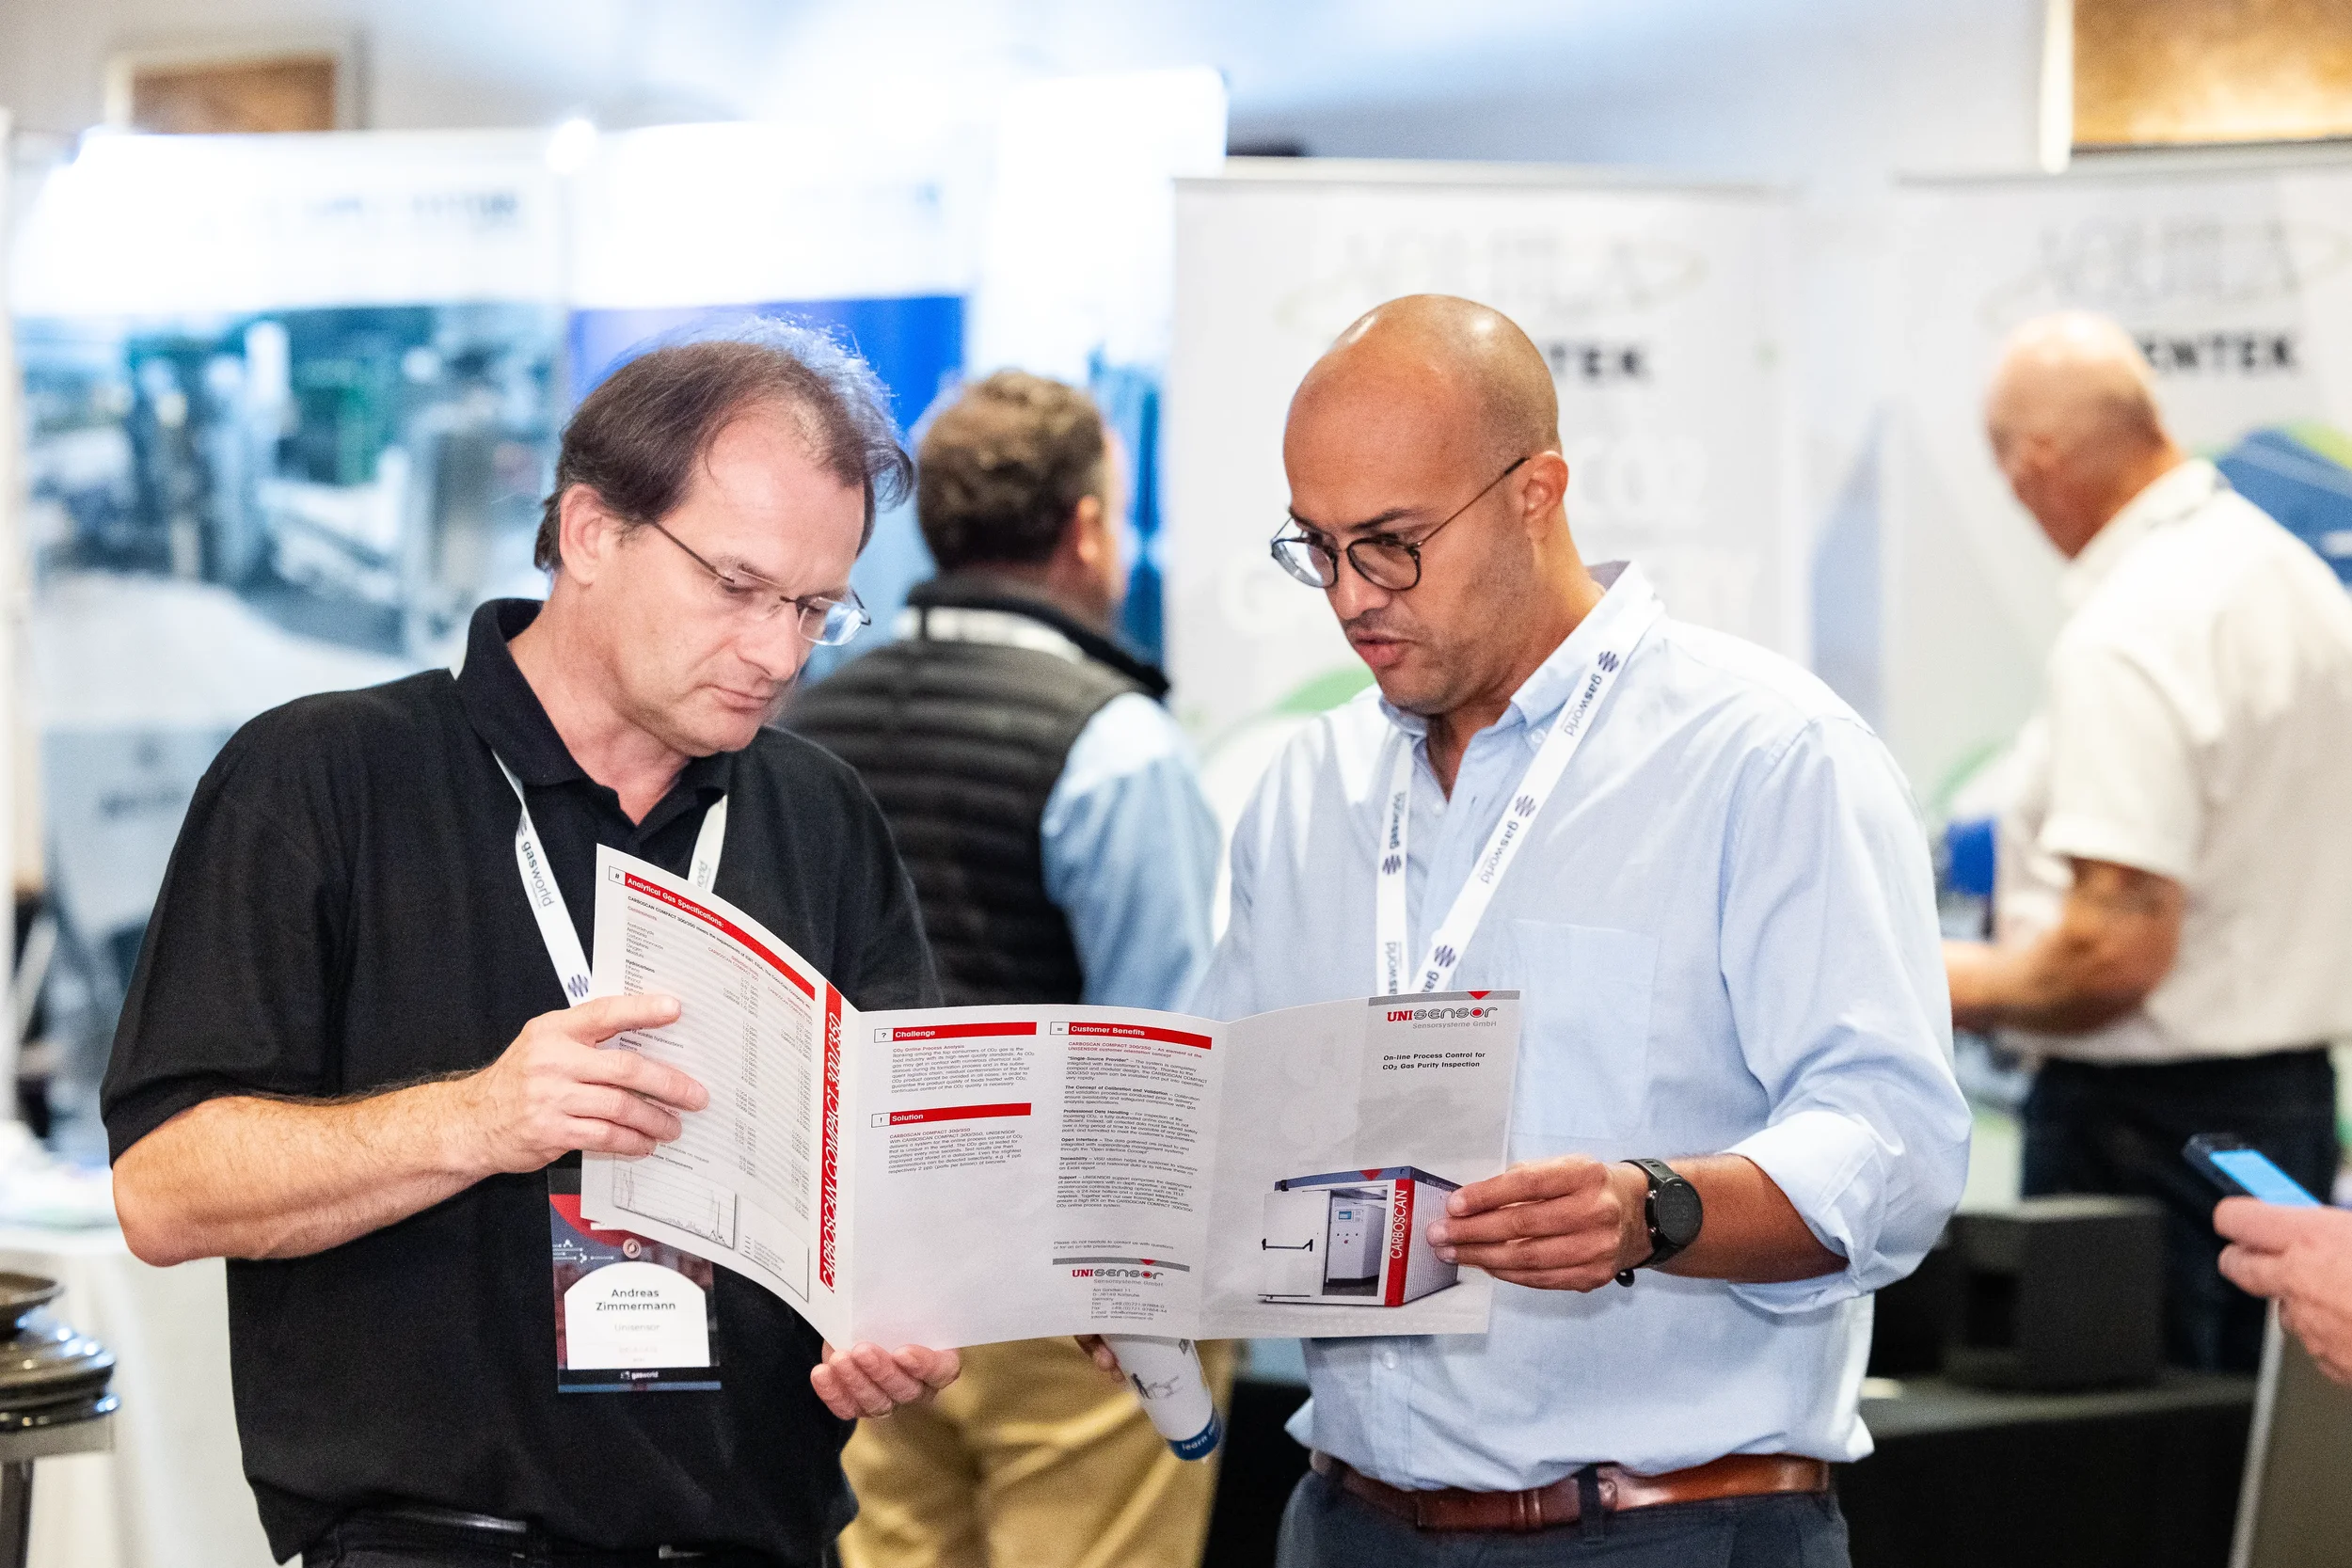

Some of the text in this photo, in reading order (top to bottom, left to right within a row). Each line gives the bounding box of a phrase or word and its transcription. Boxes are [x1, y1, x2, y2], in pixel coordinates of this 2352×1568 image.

[1565, 673, 1603, 737] gasworld
[1481, 820, 1519, 884] gasworld
[521, 841, 555, 908] gasworld
[628, 878, 660, 896] Analytical
[662, 893, 676, 903] Gas
[677, 898, 724, 927] Specifications:
[628, 895, 655, 910] CARBOSCAN
[656, 907, 676, 919] COMPACT
[1386, 942, 1398, 994] asworld
[895, 1029, 936, 1038] Challenge
[1071, 1025, 1110, 1034] Customer
[1112, 1027, 1145, 1036] Benefits
[1413, 1022, 1470, 1030] Sensorsysteme
[892, 1114, 924, 1122] Solution
[821, 1012, 842, 1294] CARBOSCAN COMPACT 300/350
[1390, 1190, 1408, 1259] CARBOSCAN
[611, 1289, 660, 1298] Andreas
[596, 1302, 676, 1311] Zimmermann
[1182, 1435, 1208, 1450] learn
